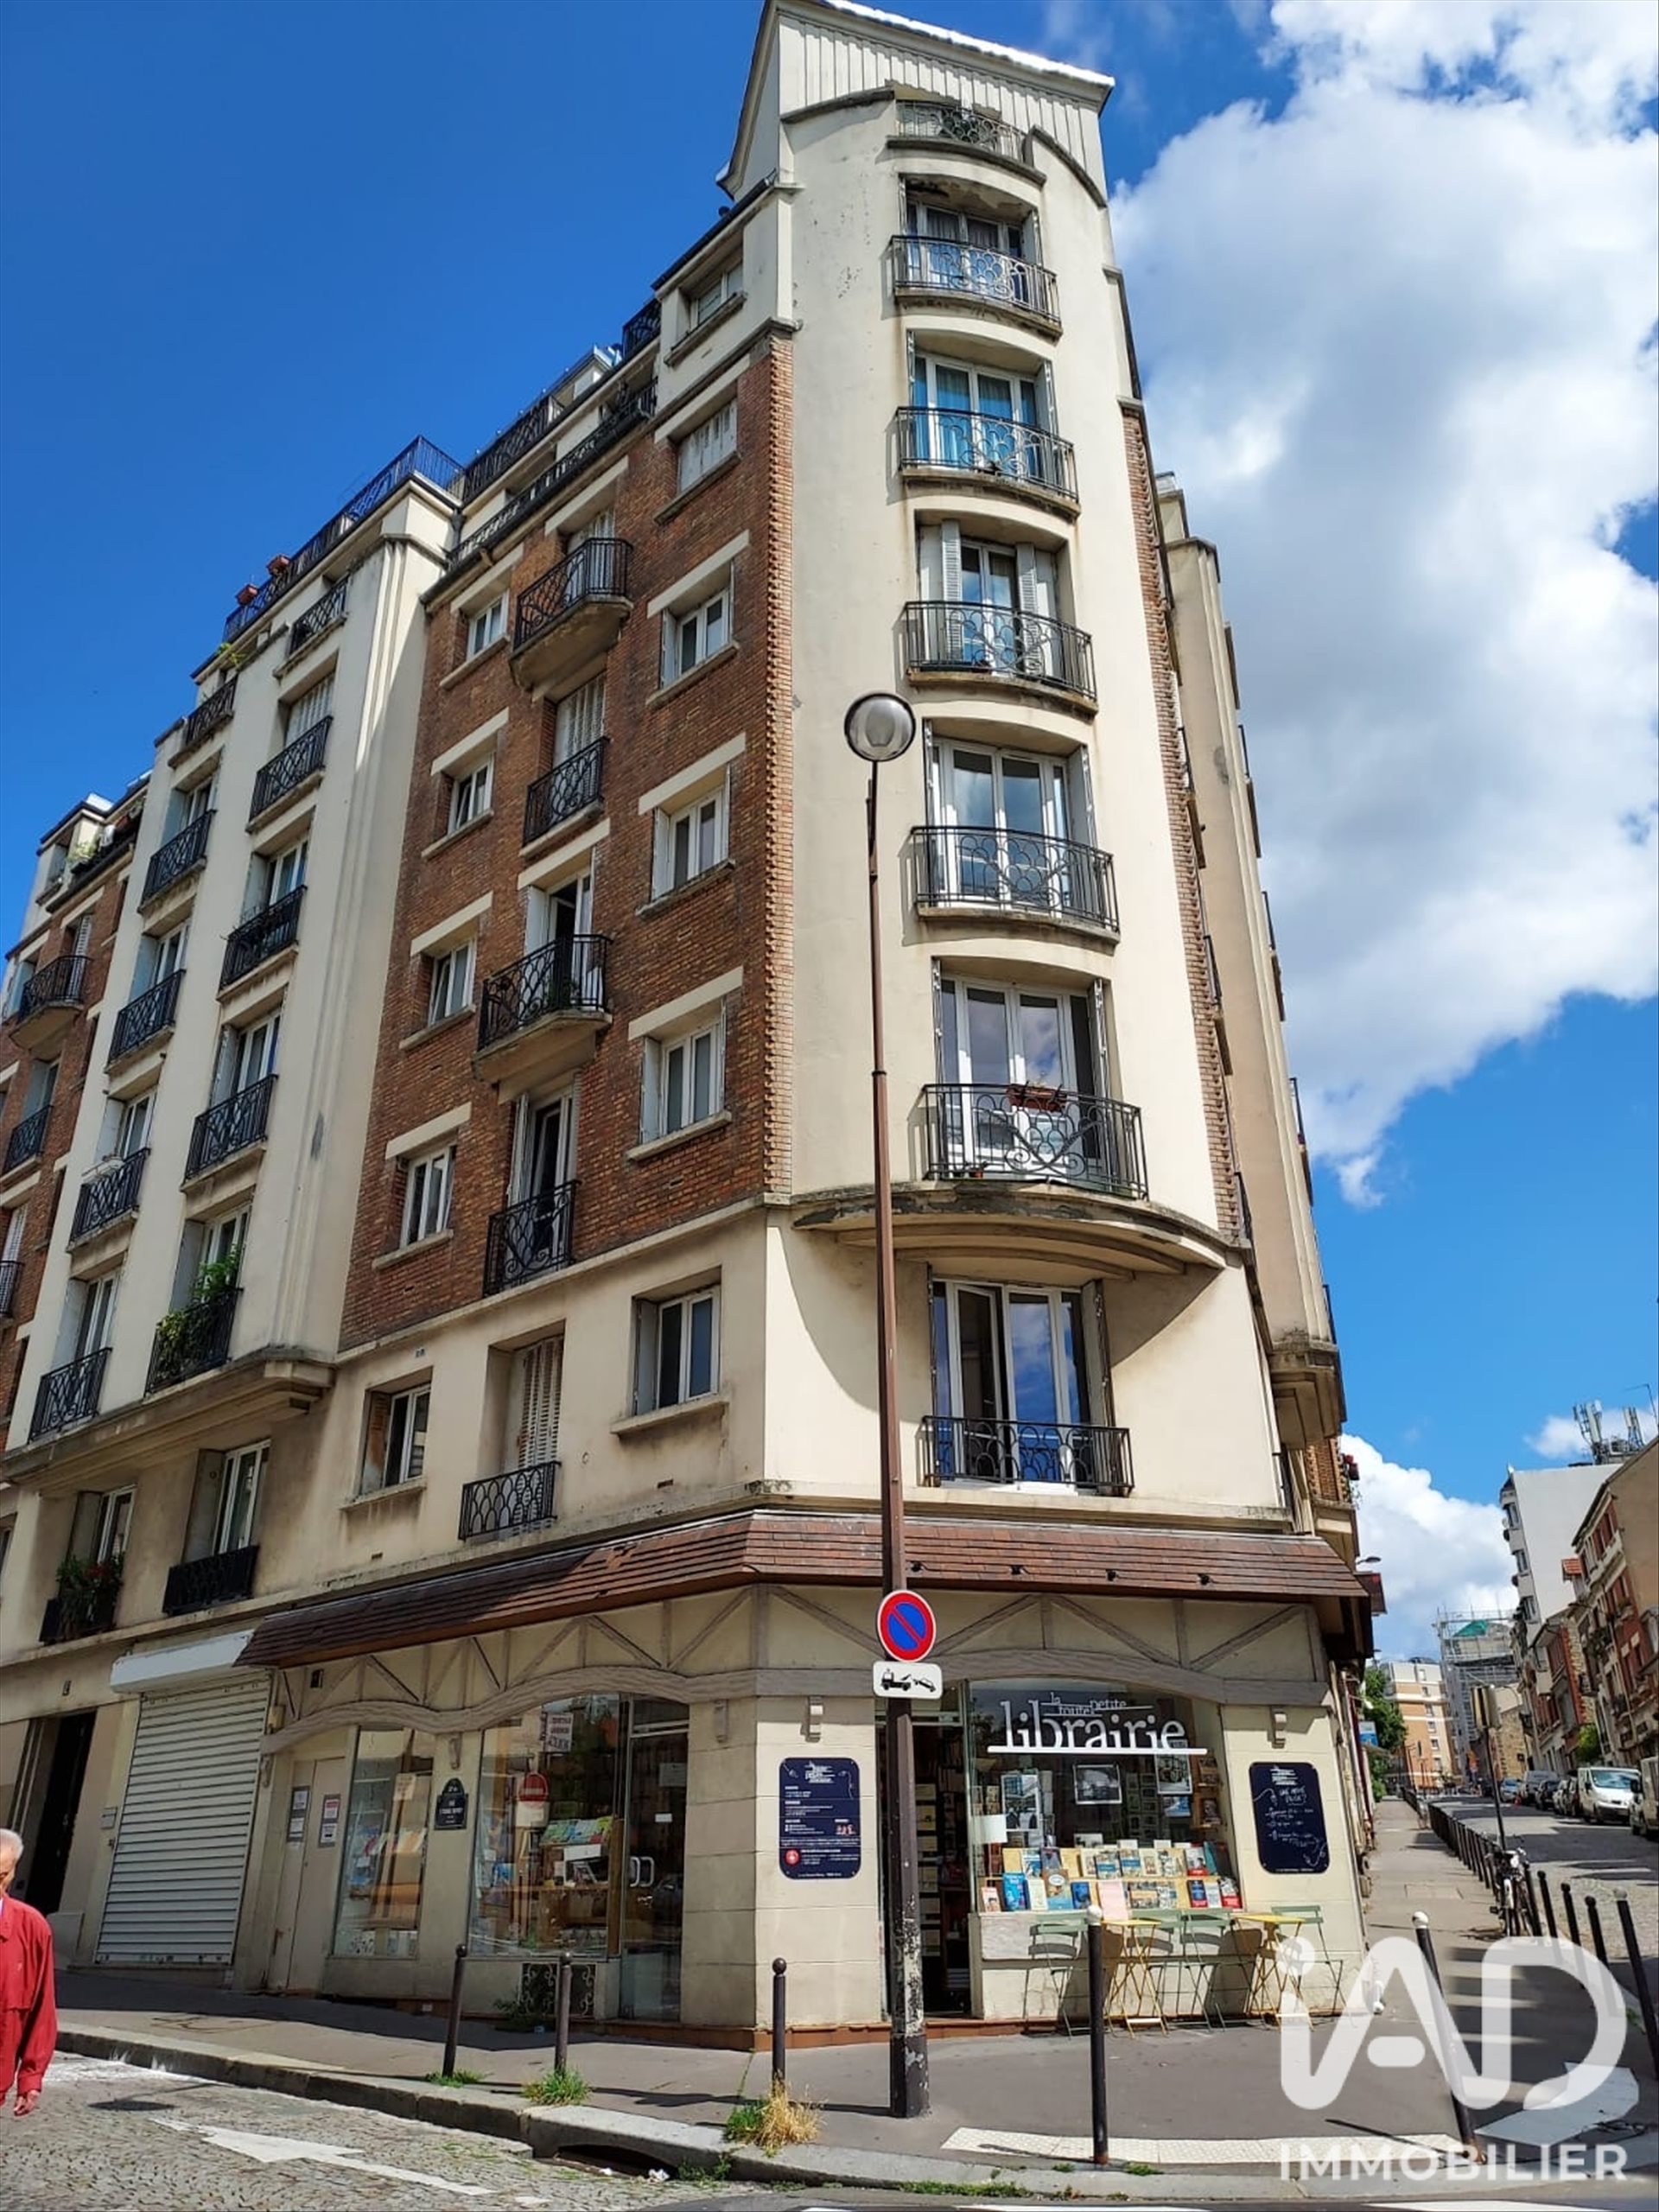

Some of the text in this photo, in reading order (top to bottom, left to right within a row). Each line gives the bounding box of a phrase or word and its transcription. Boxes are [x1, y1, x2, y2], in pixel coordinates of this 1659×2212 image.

[1050, 1692, 1061, 1704] la
[1090, 1699, 1127, 1712] petite
[1000, 1700, 1185, 1749] librairie
